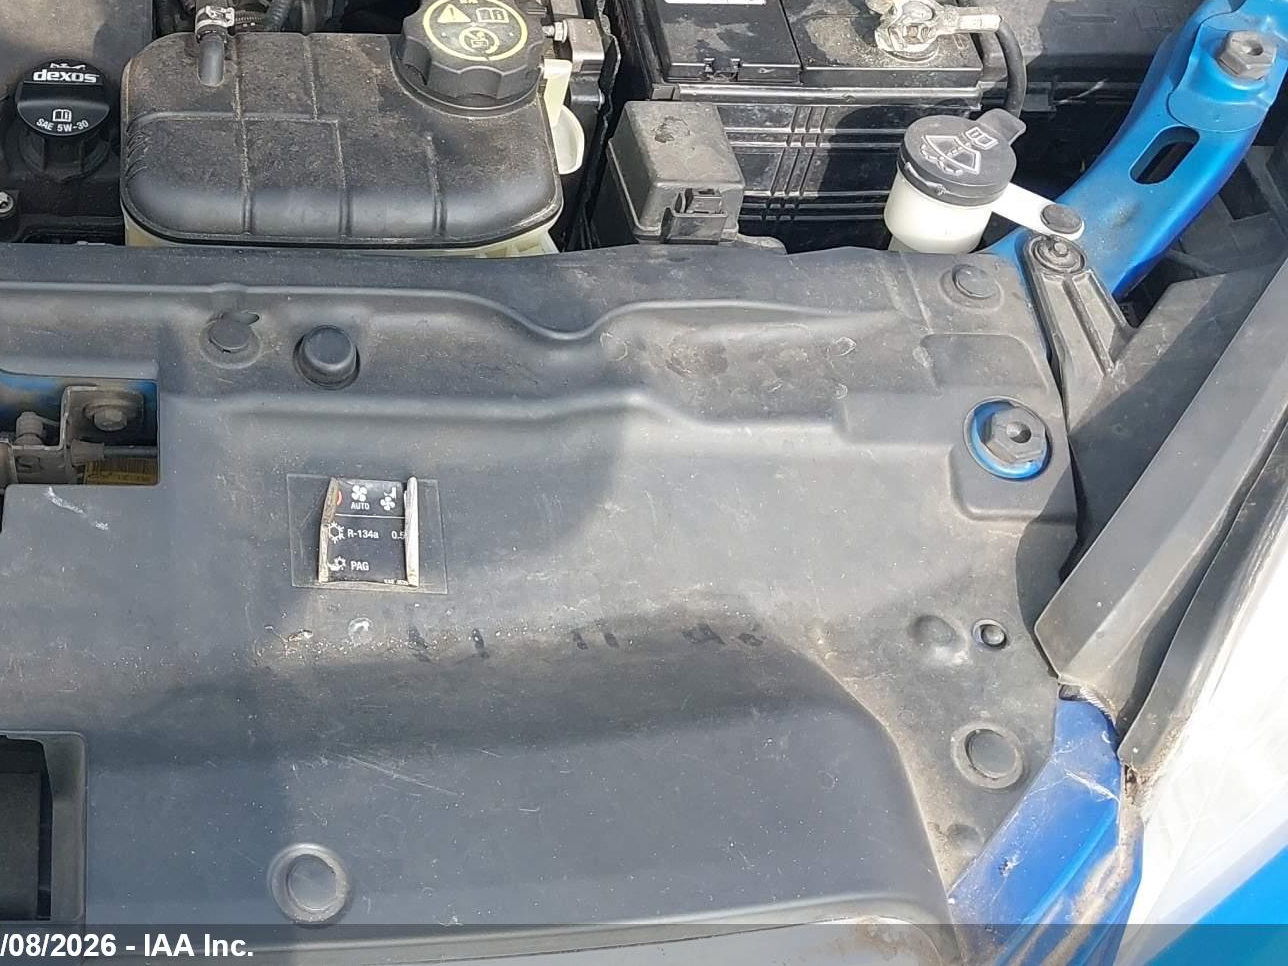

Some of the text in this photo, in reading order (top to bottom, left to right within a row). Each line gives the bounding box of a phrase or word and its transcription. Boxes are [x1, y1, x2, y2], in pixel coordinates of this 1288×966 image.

[33, 68, 100, 83] dexos
[36, 118, 89, 132] SAE 5W-30
[350, 501, 370, 510] AUTO
[347, 528, 379, 539] R-134a
[350, 561, 370, 571] PAG
